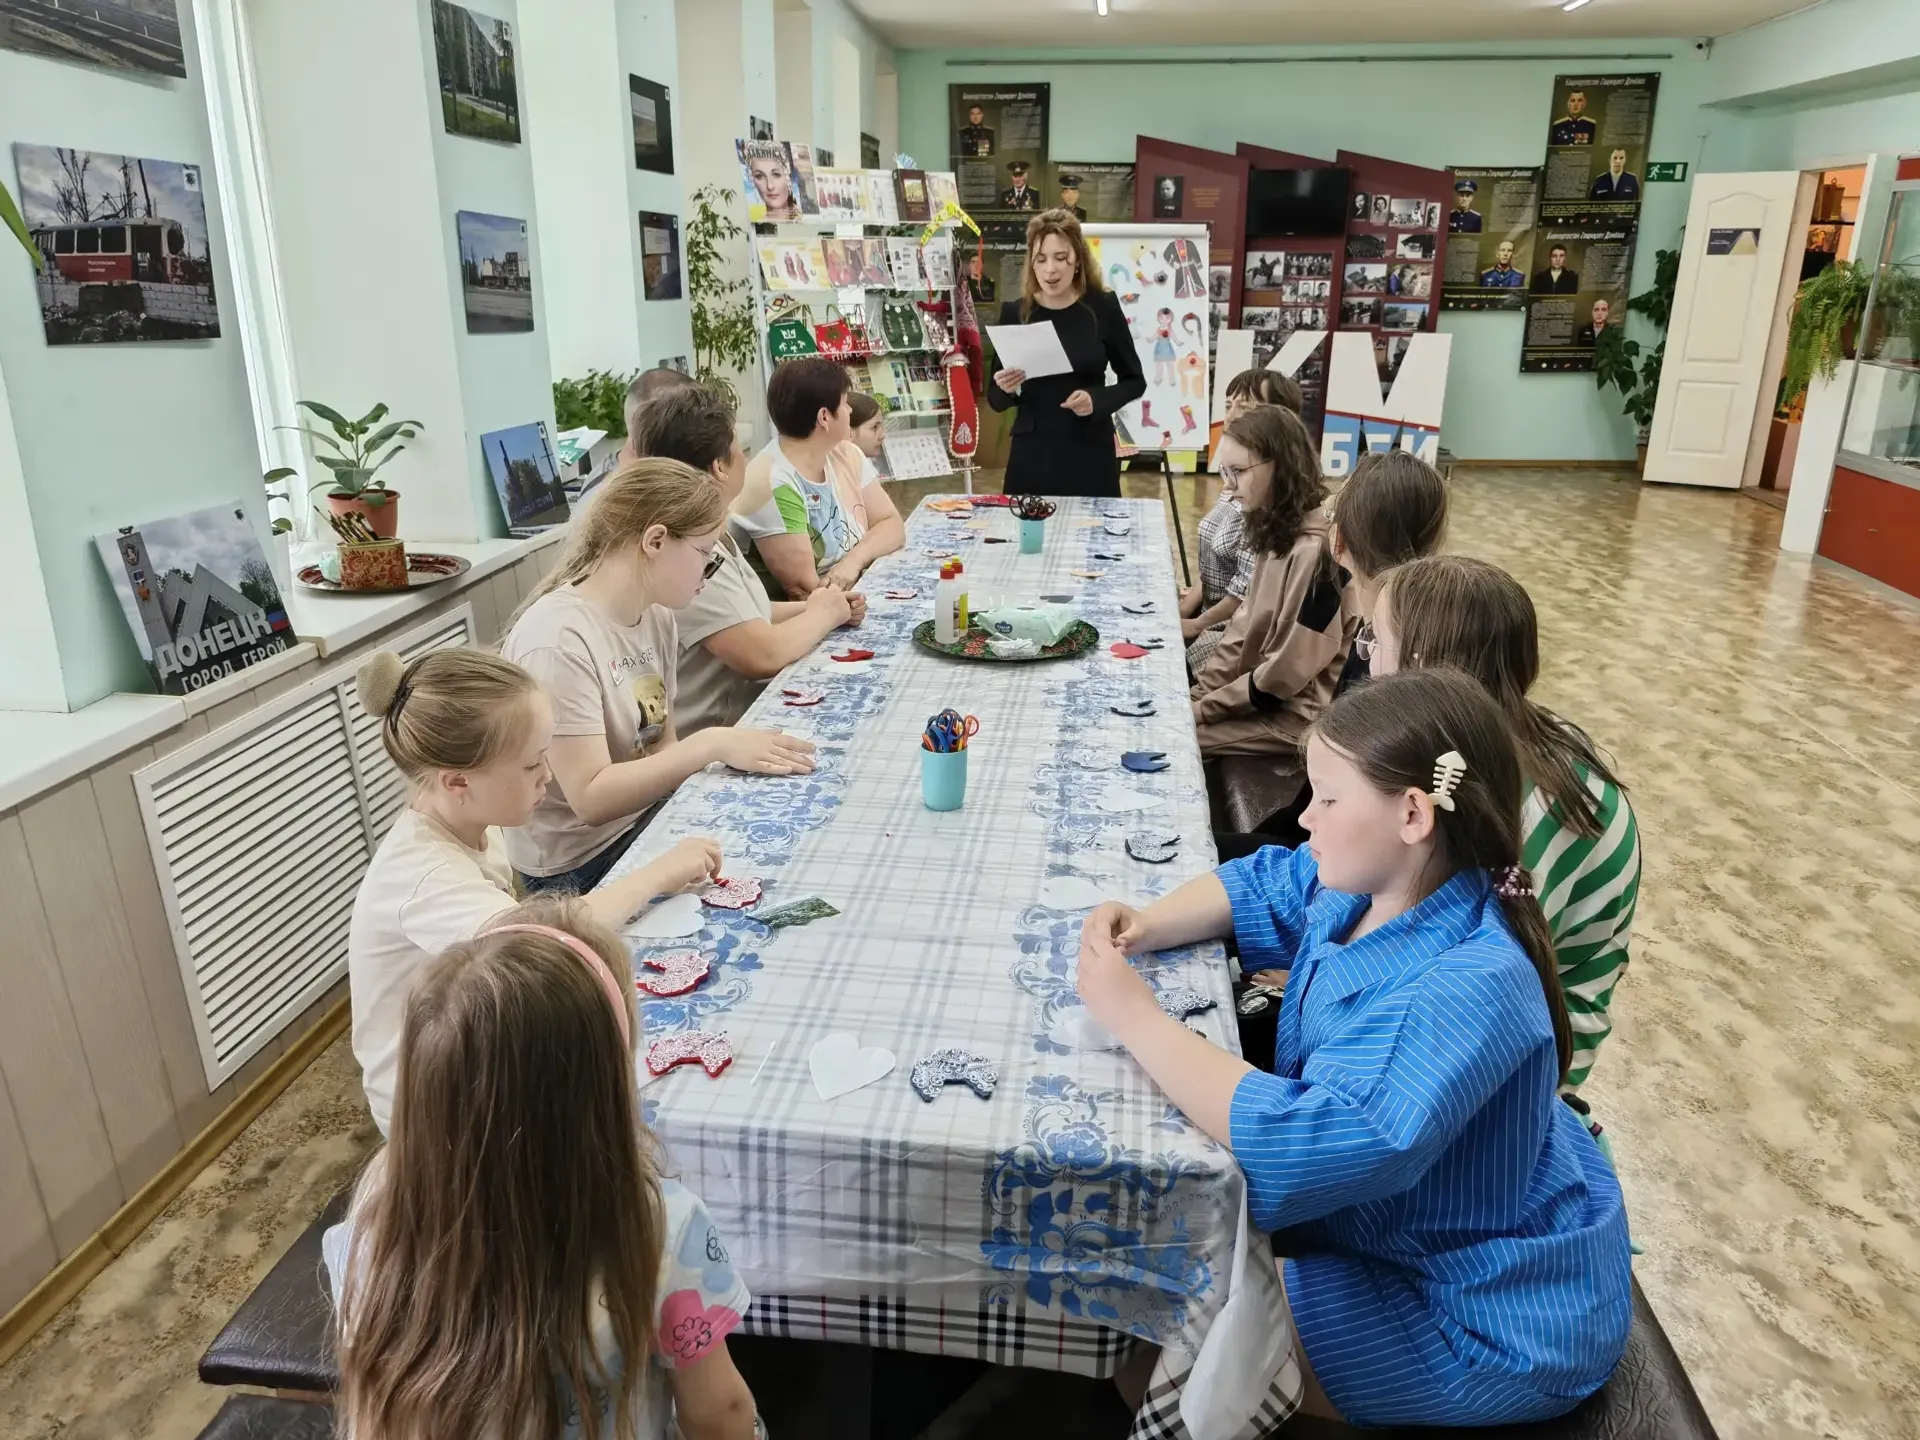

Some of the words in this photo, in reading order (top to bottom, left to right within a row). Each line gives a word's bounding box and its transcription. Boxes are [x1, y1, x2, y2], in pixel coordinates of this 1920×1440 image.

[155, 609, 273, 679] ДОНЕЦК
[181, 659, 235, 693] ГОРОД
[241, 636, 288, 667] ГЕРОЙ
